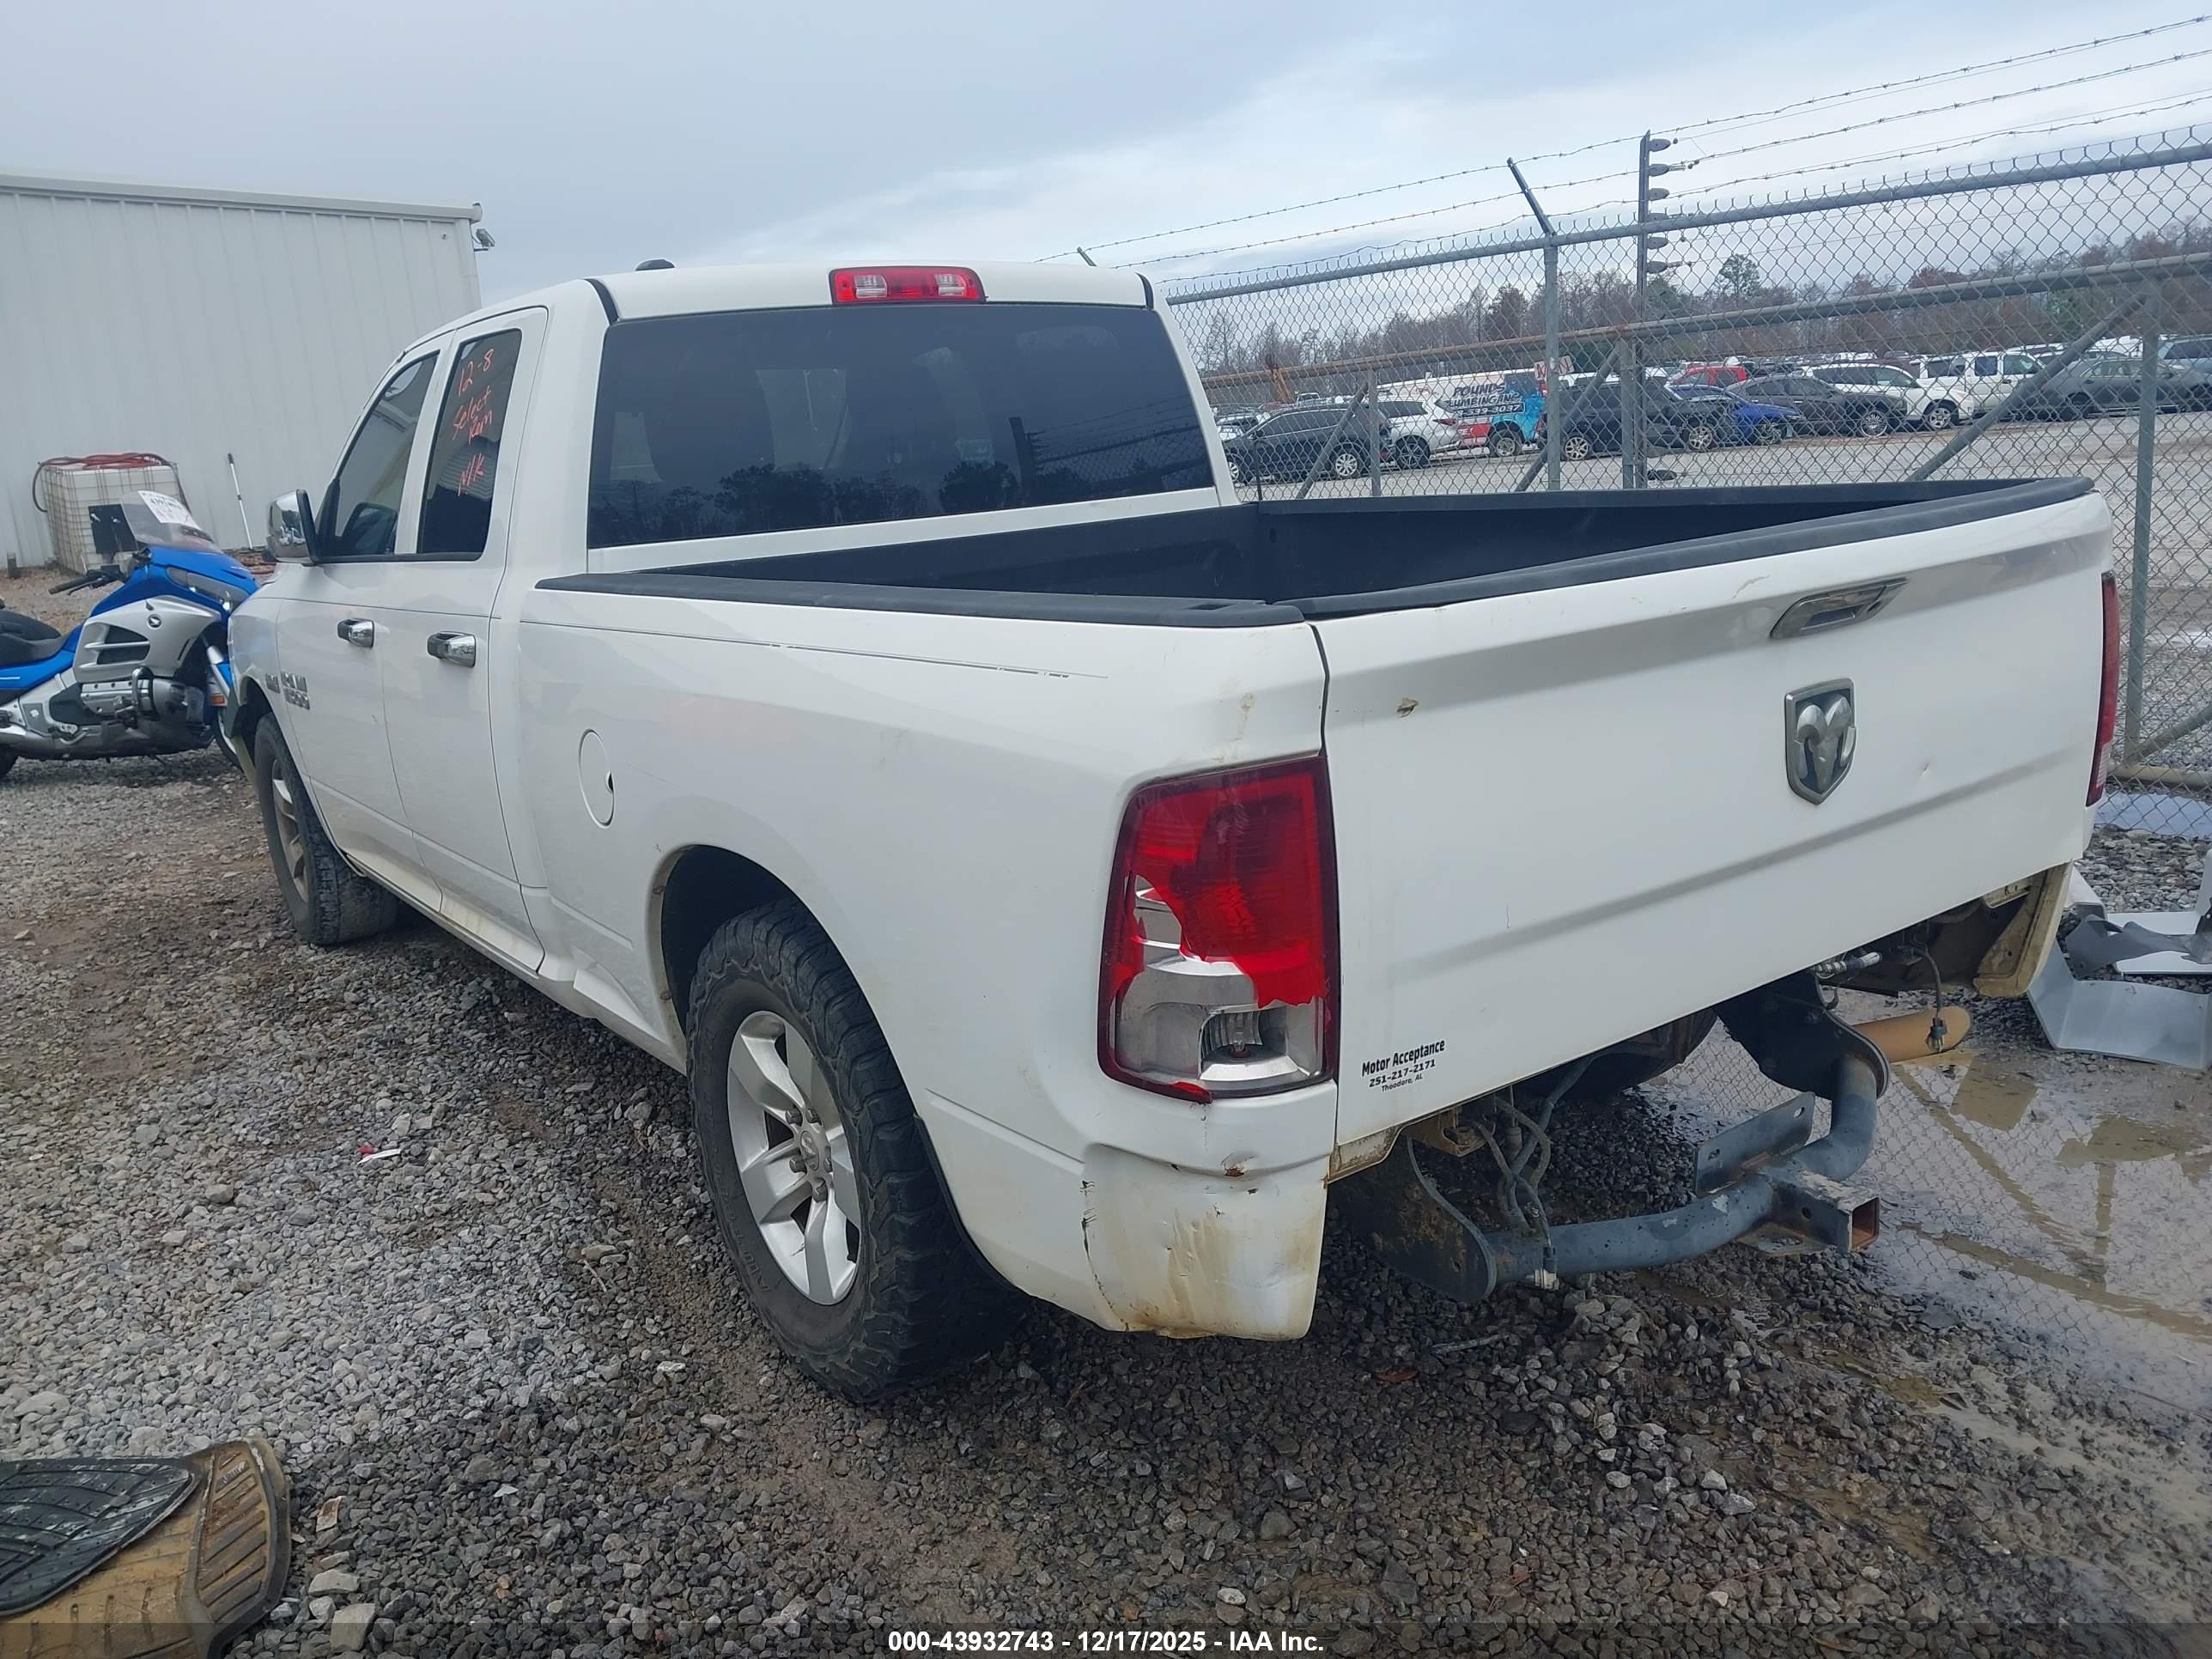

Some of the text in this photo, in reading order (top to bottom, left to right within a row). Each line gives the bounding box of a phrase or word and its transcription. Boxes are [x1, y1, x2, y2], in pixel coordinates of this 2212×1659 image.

[459, 348, 495, 397] 12-8
[1452, 383, 1506, 397] POUNDS
[1361, 1039, 1446, 1077] Motor Acceptance
[1369, 1059, 1437, 1088] 251-217-2171
[1381, 1073, 1424, 1092] Theodore, AL
